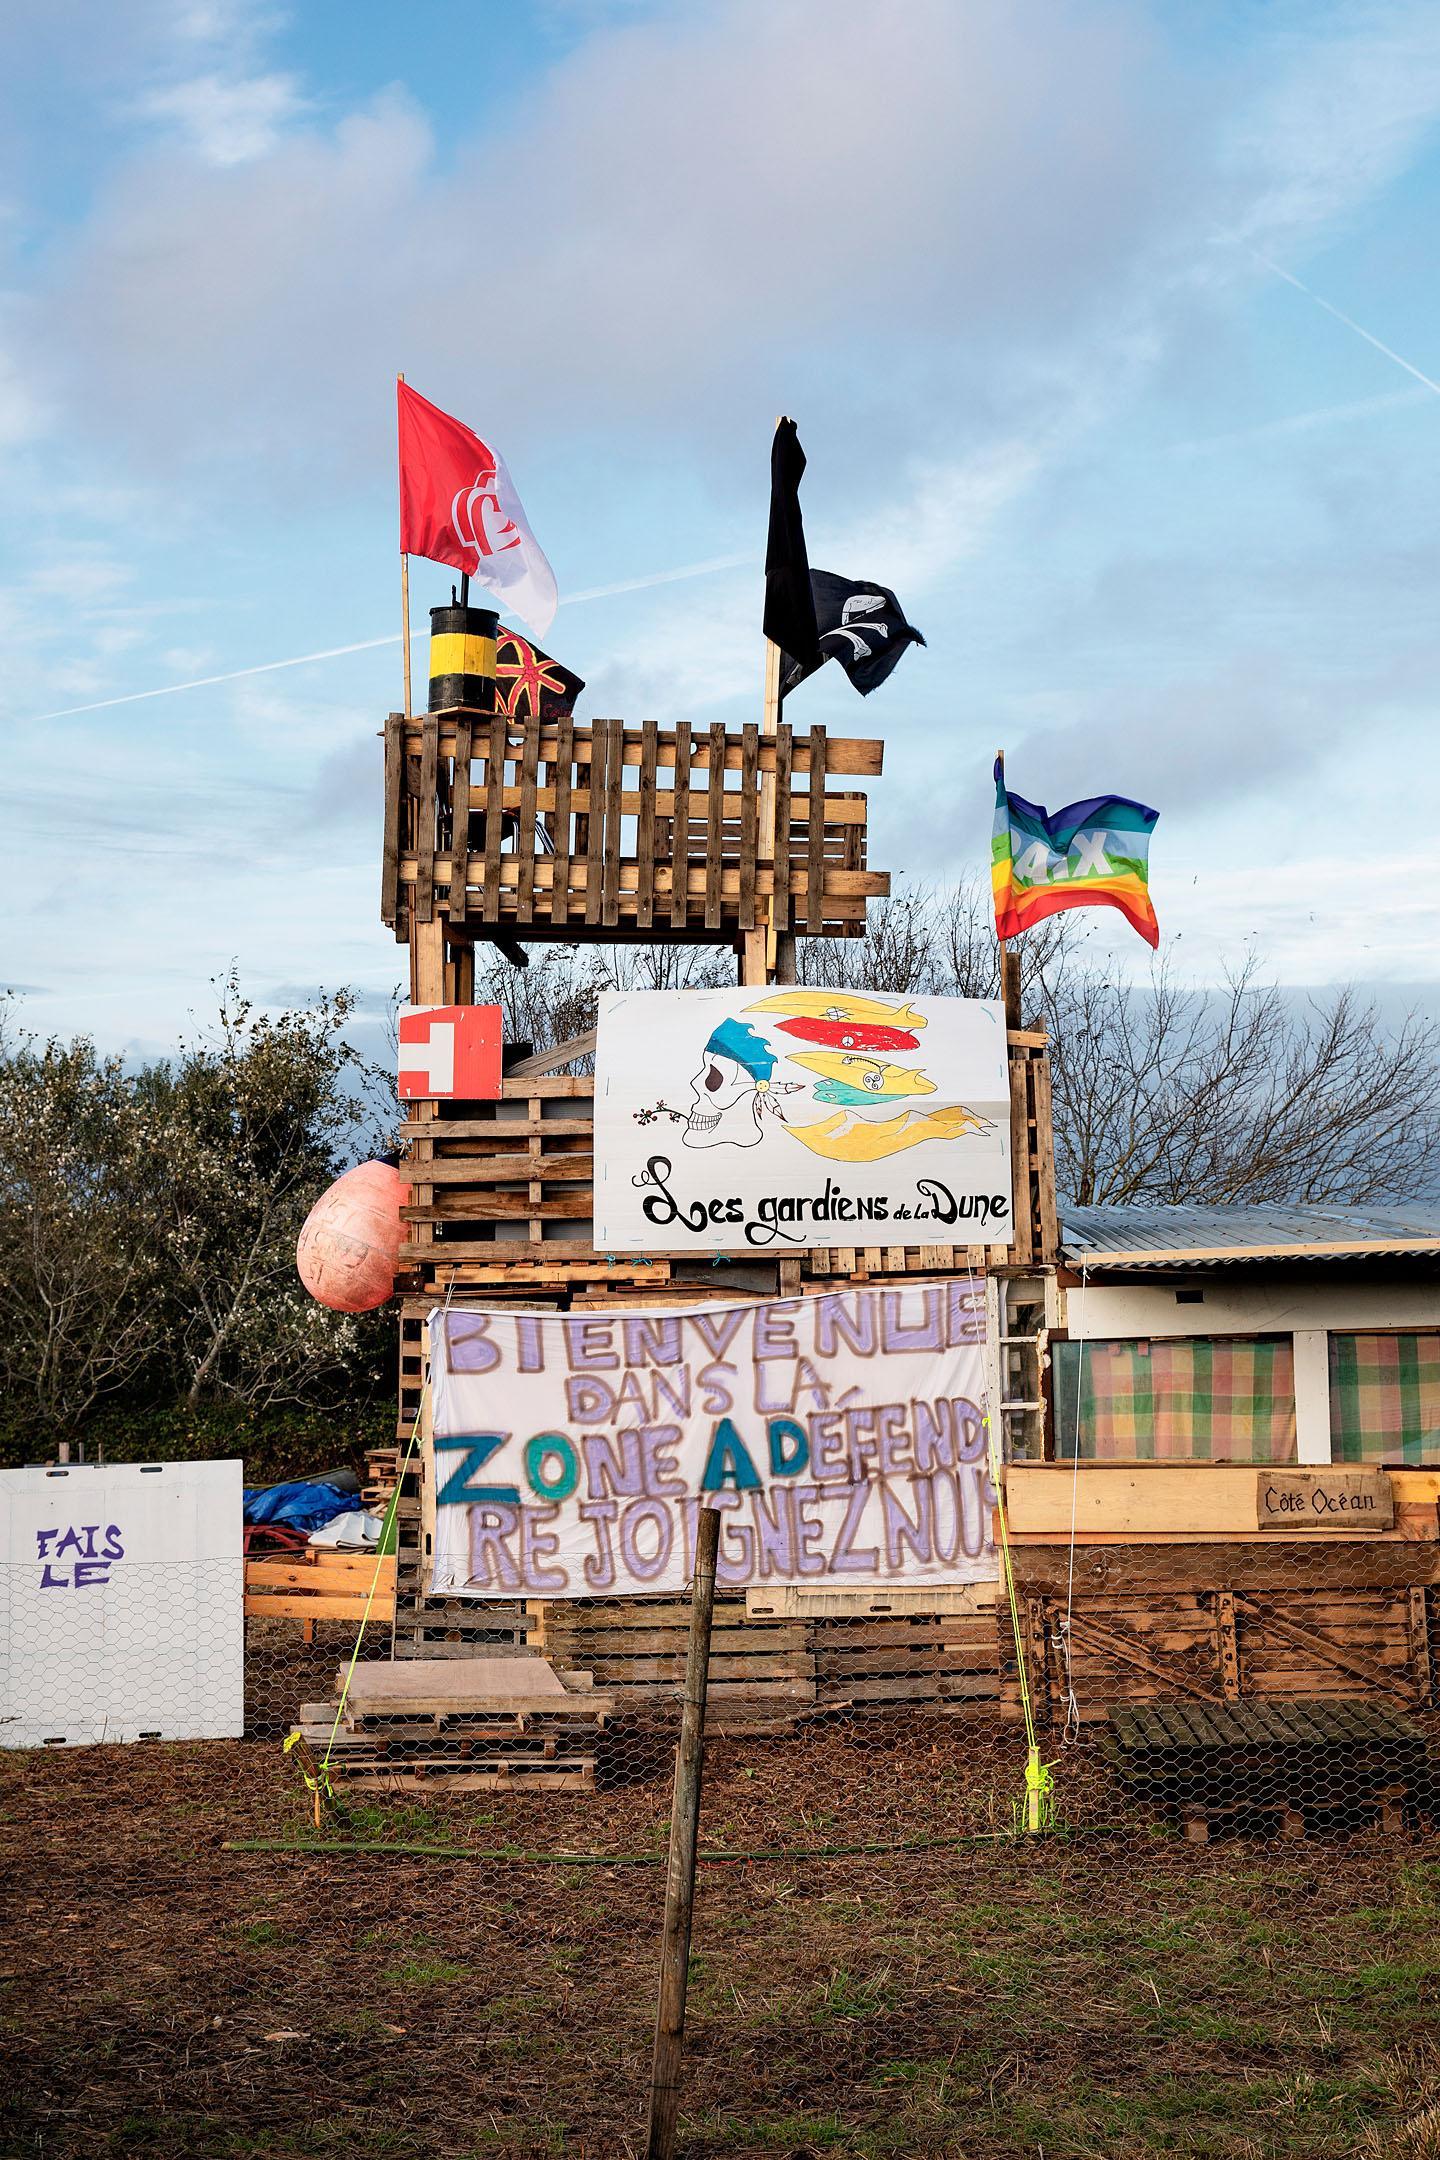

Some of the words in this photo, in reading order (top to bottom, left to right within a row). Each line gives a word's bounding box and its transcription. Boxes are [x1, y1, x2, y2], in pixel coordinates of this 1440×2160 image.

[632, 1156, 744, 1232] Les
[893, 1203, 913, 1220] de
[916, 1179, 1009, 1226] Dune
[444, 1279, 987, 1375] BIENVENUE
[564, 1361, 737, 1426] DANS
[753, 1356, 832, 1415] LA
[434, 1424, 687, 1505] ZONE
[1265, 1487, 1305, 1513] Côté
[1312, 1488, 1376, 1514] Océan
[37, 1524, 124, 1560] FAIS
[40, 1561, 112, 1589] LE
